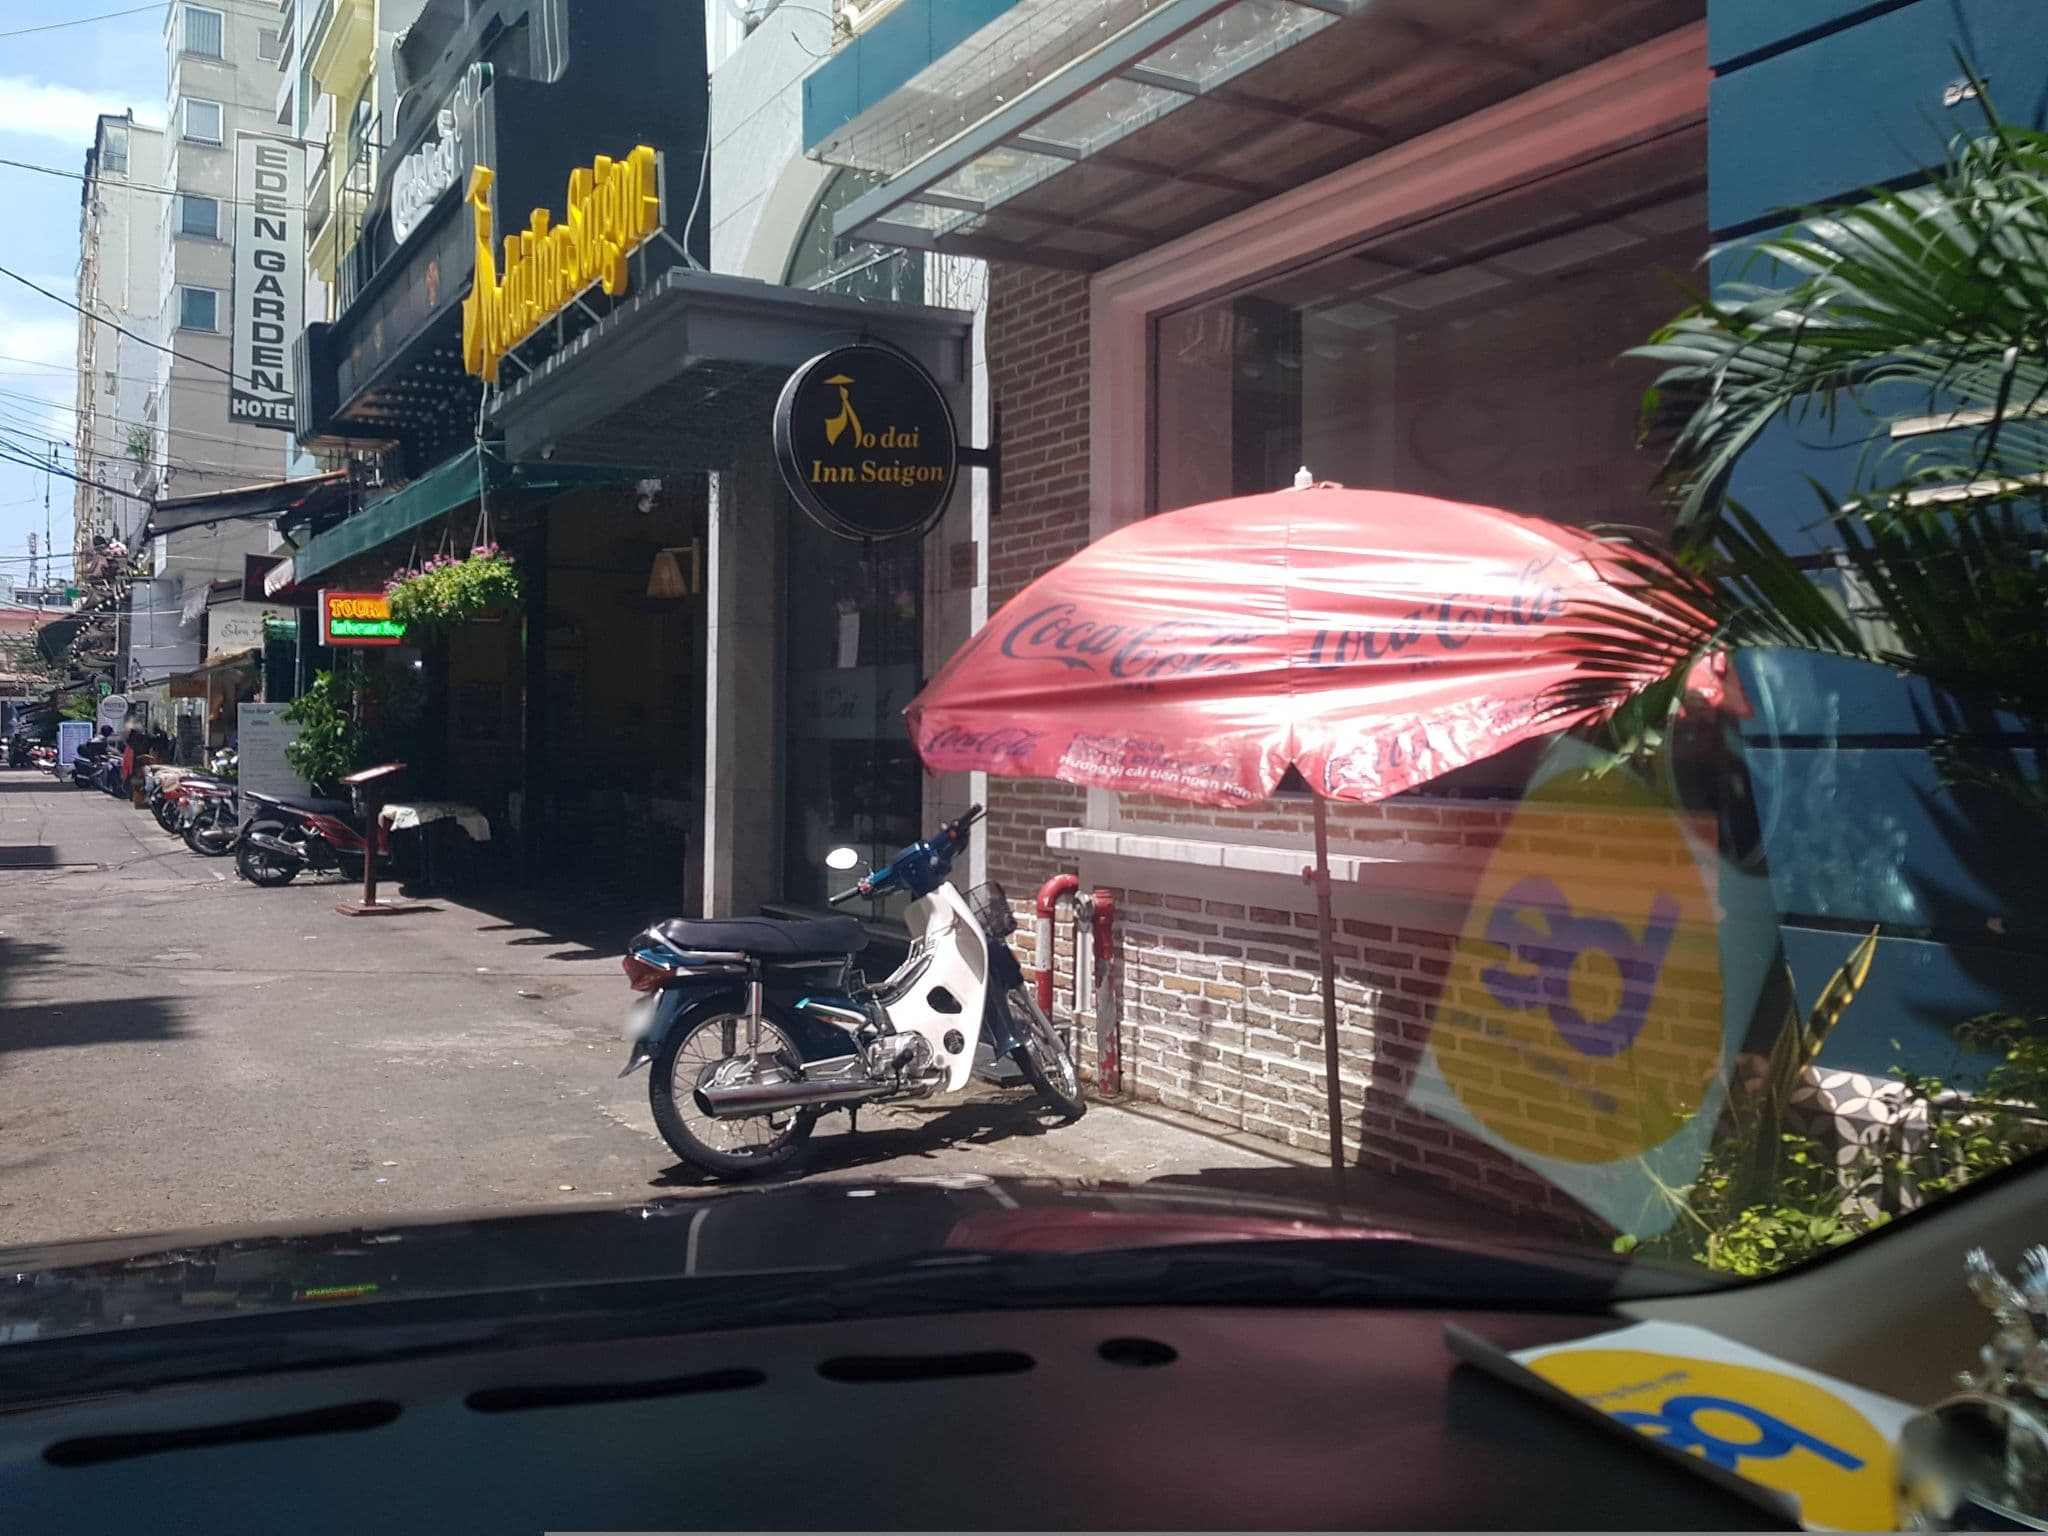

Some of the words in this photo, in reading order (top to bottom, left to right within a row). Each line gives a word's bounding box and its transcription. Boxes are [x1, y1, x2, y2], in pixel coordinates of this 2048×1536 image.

[254, 144, 287, 242] EDEN
[567, 145, 658, 296] Saigon
[251, 250, 285, 391] GARDEN
[232, 398, 295, 421] HOTEL
[811, 460, 856, 483] Inn
[861, 460, 944, 487] Saigon
